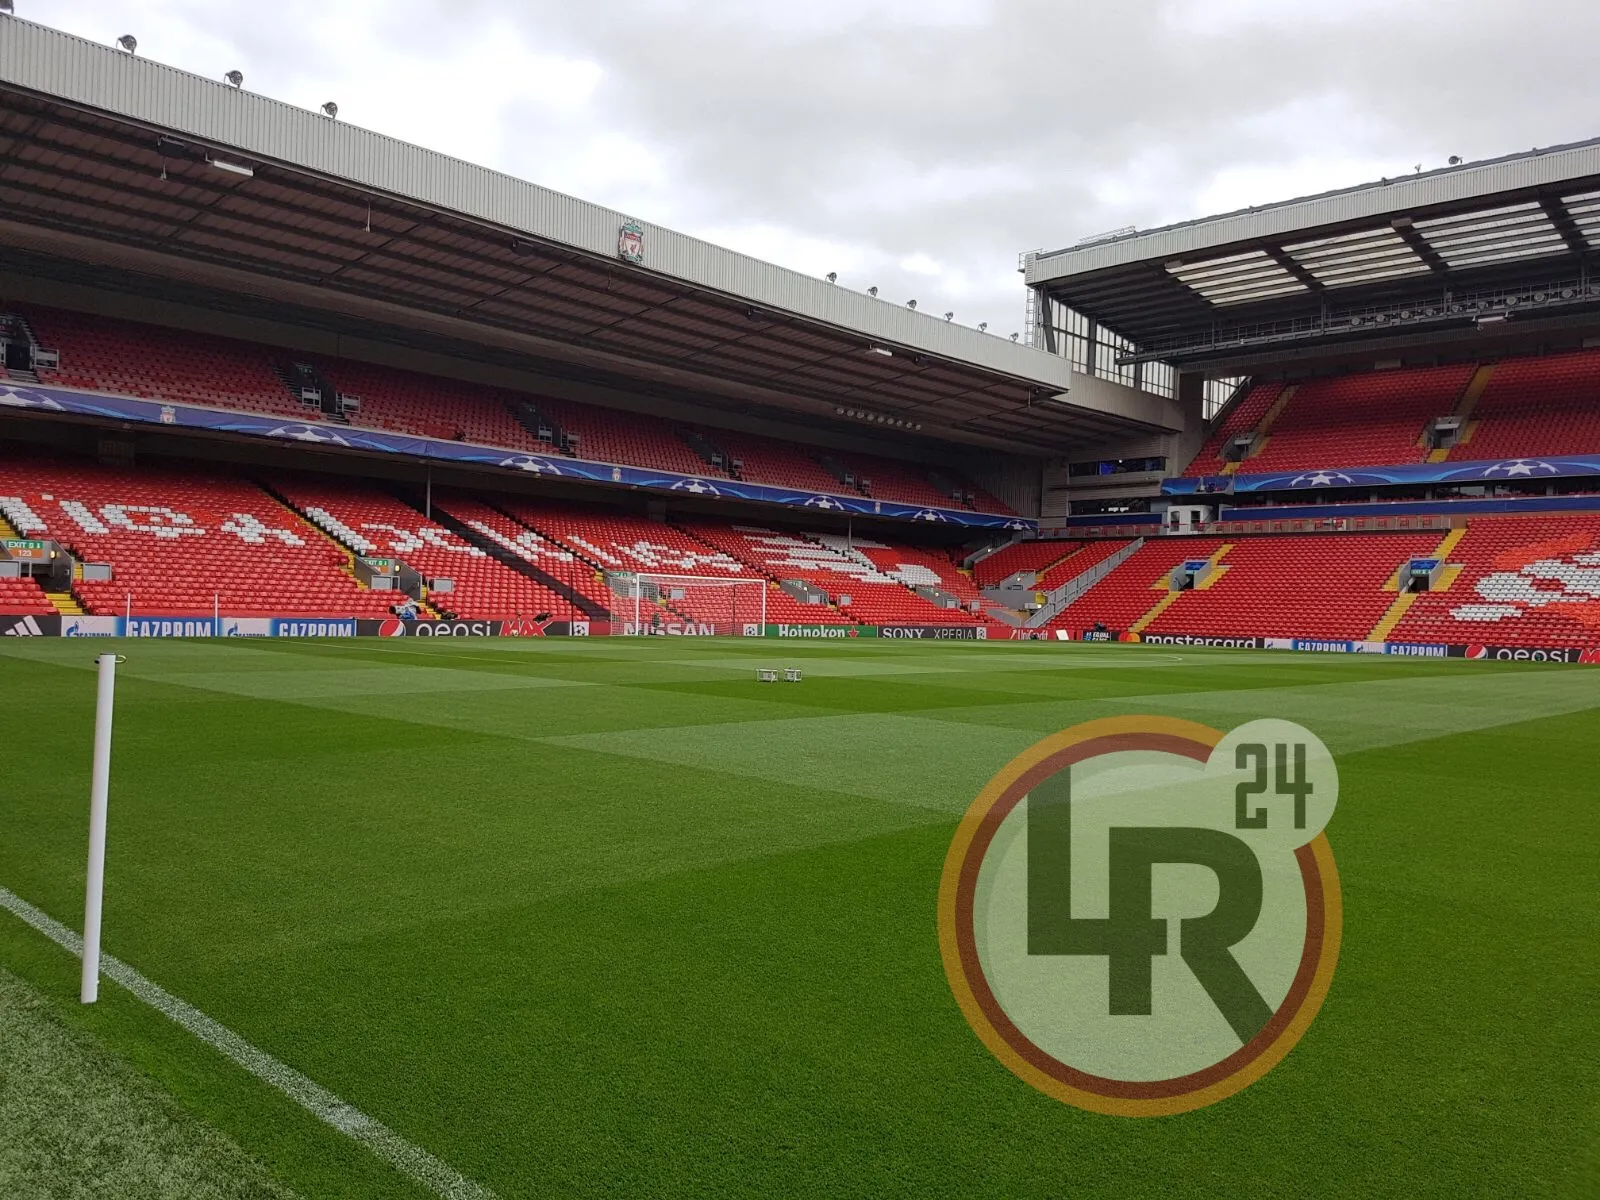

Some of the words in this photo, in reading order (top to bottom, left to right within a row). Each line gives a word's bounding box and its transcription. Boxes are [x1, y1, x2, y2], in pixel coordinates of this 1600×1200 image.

[8, 541, 27, 549] EXIT
[128, 620, 211, 637] GAZPROM
[279, 623, 352, 637] GAZPROM
[623, 622, 715, 636] NISSAN
[778, 619, 846, 638] Heineken
[882, 627, 925, 639] SONY
[934, 628, 974, 640] XPERIA
[1145, 634, 1256, 649] mastercard
[1390, 645, 1444, 657] GAZPROM
